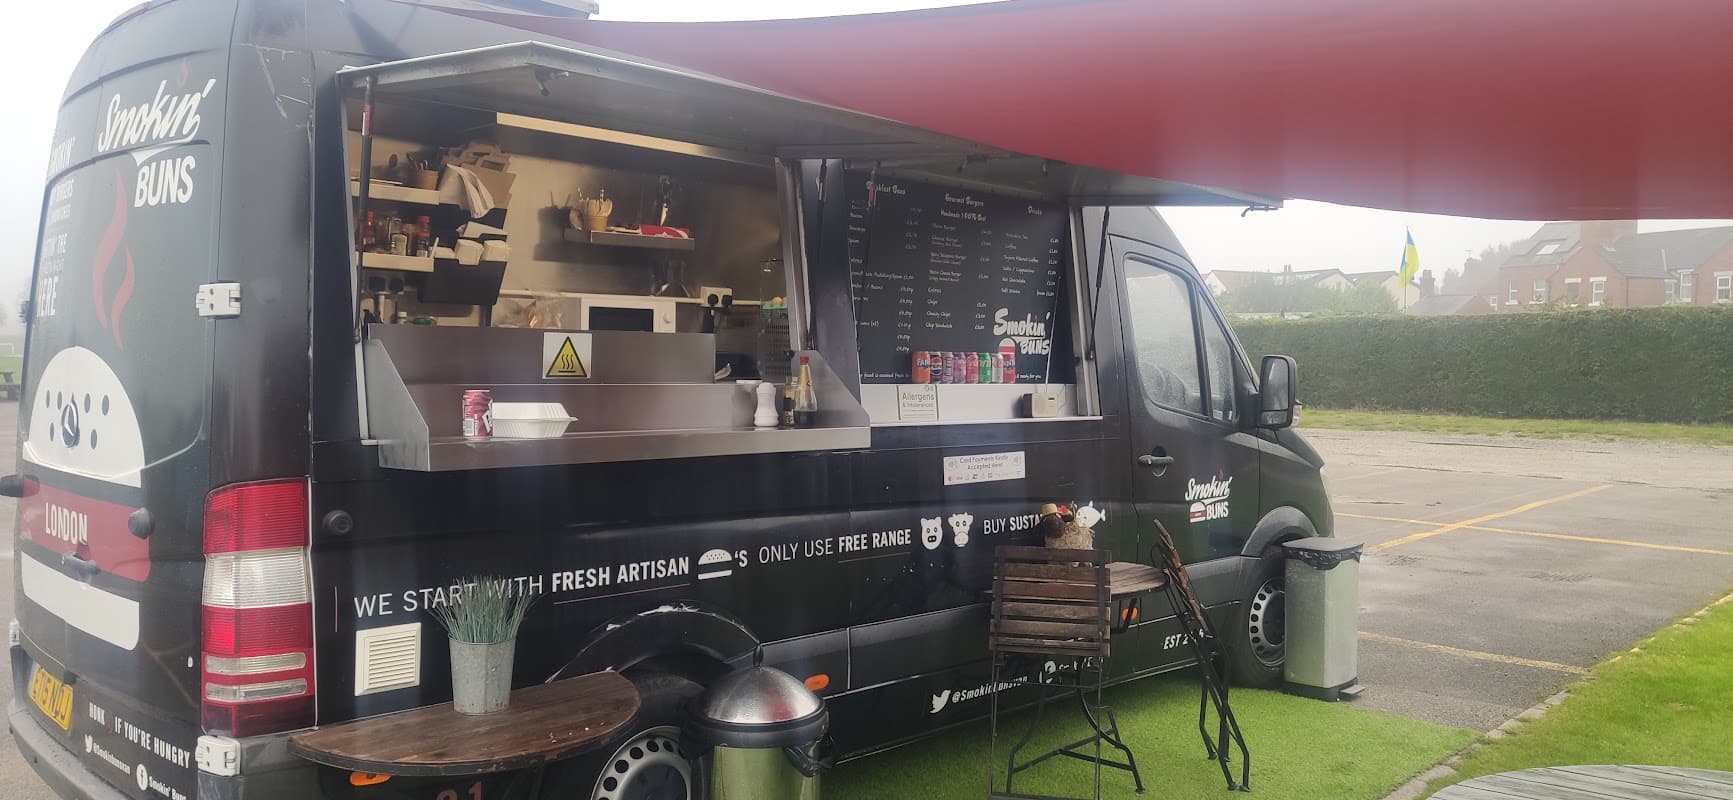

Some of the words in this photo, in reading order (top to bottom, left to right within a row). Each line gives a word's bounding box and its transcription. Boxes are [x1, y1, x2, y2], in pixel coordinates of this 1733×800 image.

[98, 79, 216, 152] Smokin'
[134, 155, 195, 207] BUNS
[993, 308, 1050, 336] Smokin'
[902, 392, 935, 405] Allergens
[1185, 475, 1232, 501] Smokin'
[45, 502, 88, 545] LONDON
[1206, 501, 1229, 520] BUNS
[353, 592, 393, 619] WE
[552, 566, 610, 593] FRESH
[617, 556, 689, 584] ARTISAN
[758, 541, 797, 565] ONLY
[804, 538, 833, 557] USE
[838, 533, 868, 553] FREE
[872, 529, 912, 548] RANGE
[983, 518, 1006, 535] BUY
[1009, 513, 1043, 532] SUSTA
[1163, 633, 1182, 650] EST
[115, 716, 123, 735] IF
[124, 721, 151, 751] YOU'RE
[154, 737, 190, 769] HUNGRY
[149, 775, 171, 798] Smokin'
